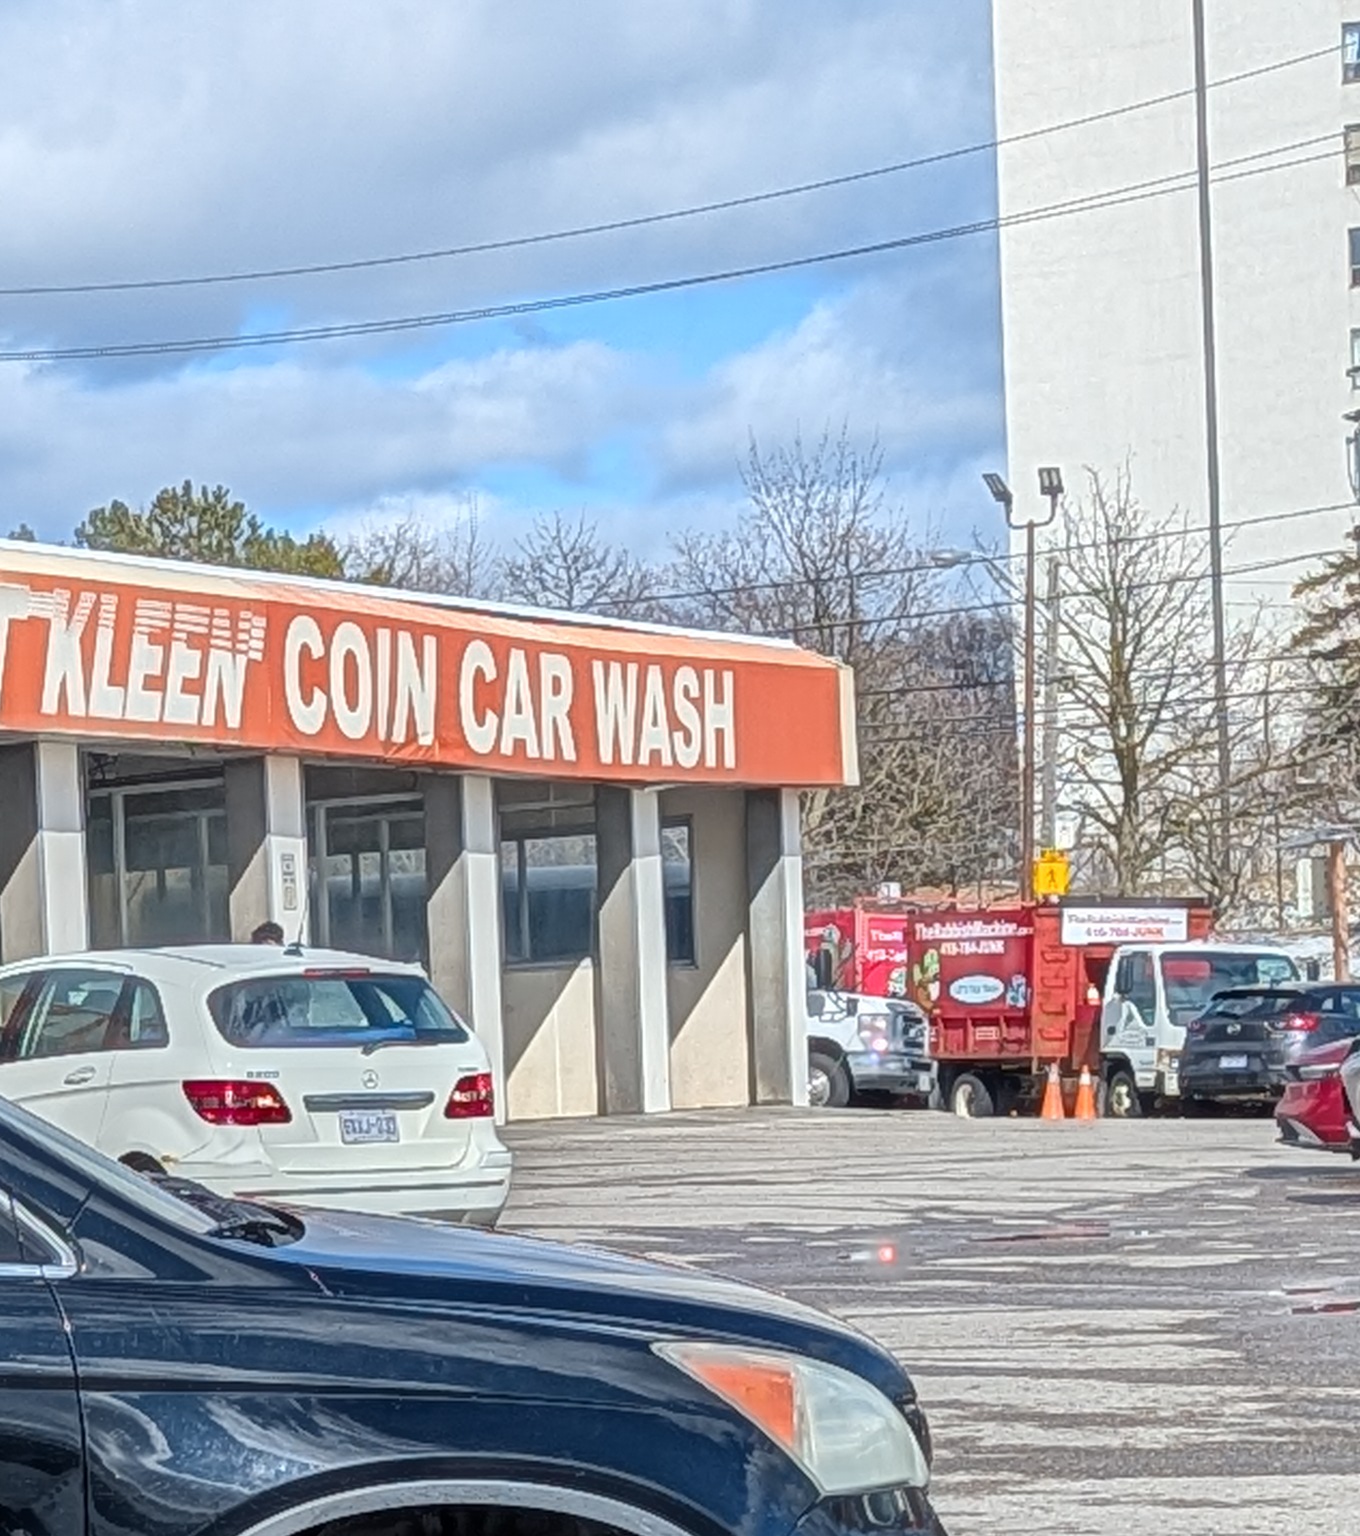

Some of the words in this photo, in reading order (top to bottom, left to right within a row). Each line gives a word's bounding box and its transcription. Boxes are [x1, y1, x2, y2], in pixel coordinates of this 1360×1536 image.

[38, 588, 267, 728] KLEEN
[284, 615, 438, 746] COIN
[459, 639, 577, 762] CAR
[592, 659, 736, 769] WASH
